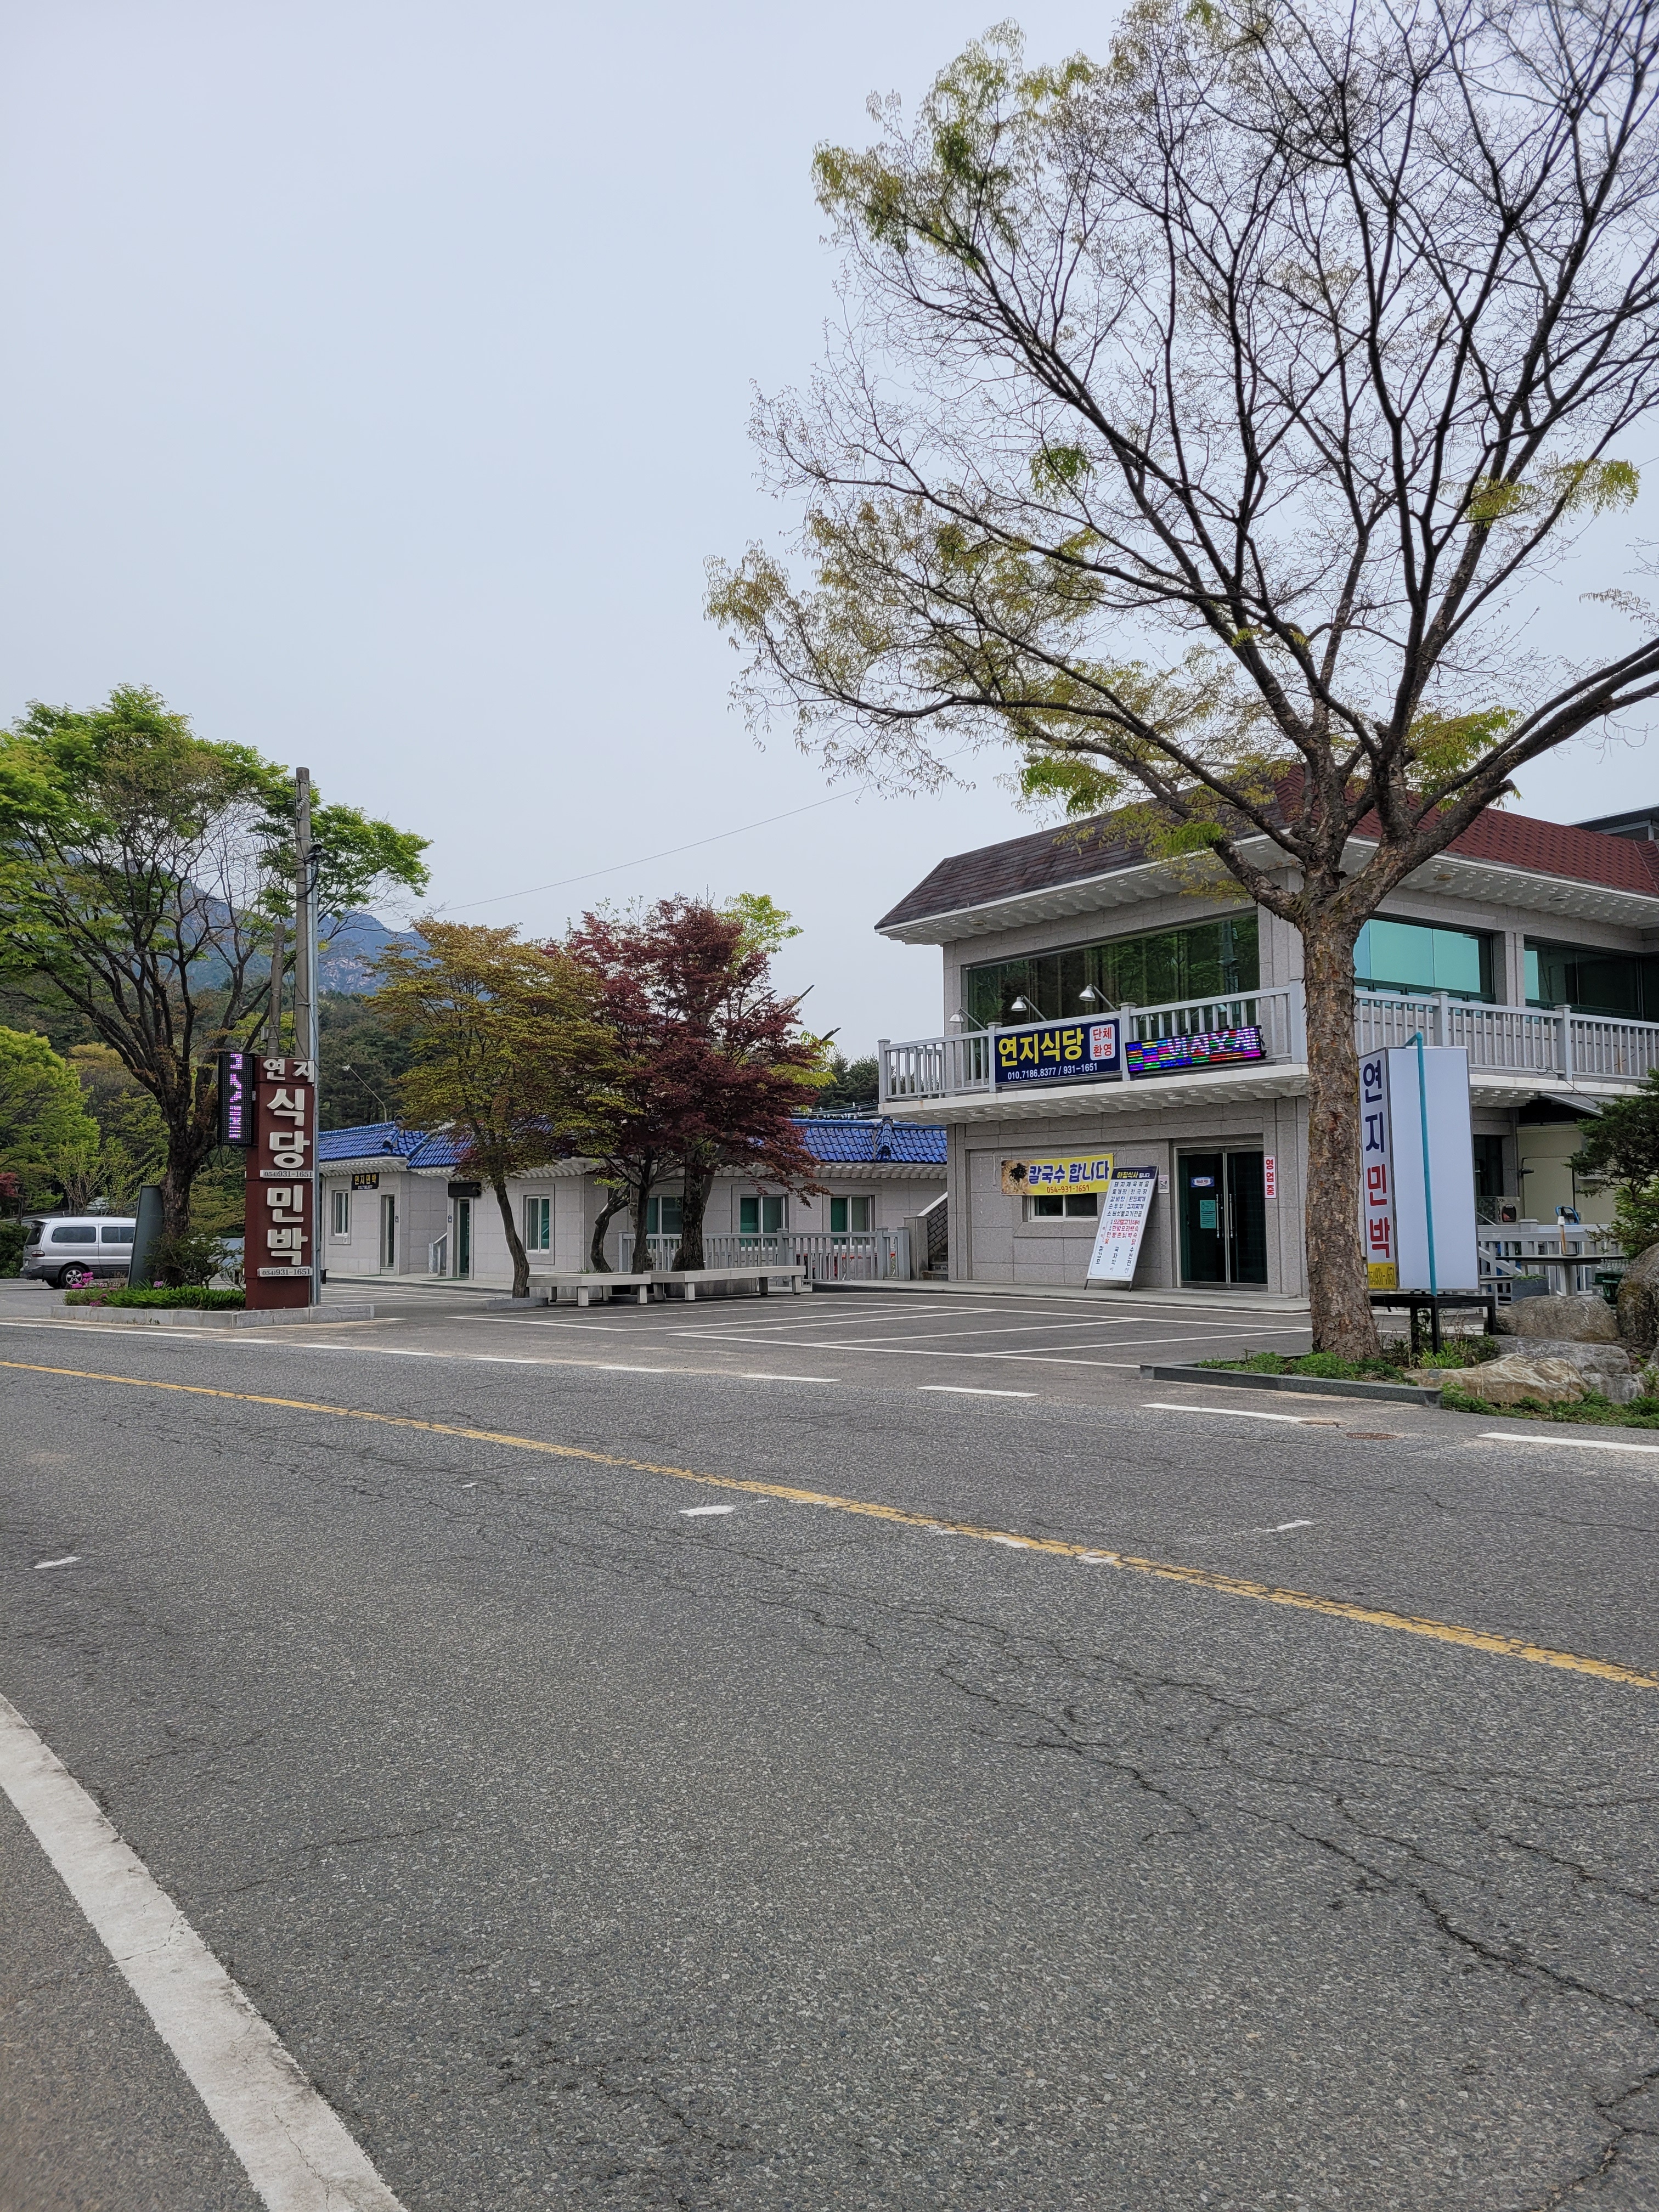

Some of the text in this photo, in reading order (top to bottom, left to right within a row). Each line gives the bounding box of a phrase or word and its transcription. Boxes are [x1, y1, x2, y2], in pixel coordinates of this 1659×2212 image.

[1092, 1026, 1113, 1042] 단체
[998, 1027, 1084, 1068] 연지식당
[1093, 1043, 1113, 1058] 환영
[263, 1058, 314, 1082] 연지
[1007, 1066, 1056, 1080] 010.7186.8377
[1063, 1062, 1098, 1075] 931-1651
[267, 1088, 311, 1169] 식당
[354, 1174, 377, 1185] 연지민박
[1029, 1160, 1110, 1184] 칼국수 합니다
[1266, 1159, 1274, 1195] 영업중
[1046, 1184, 1090, 1193] 054-931-1651
[267, 1184, 308, 1266] 민박
